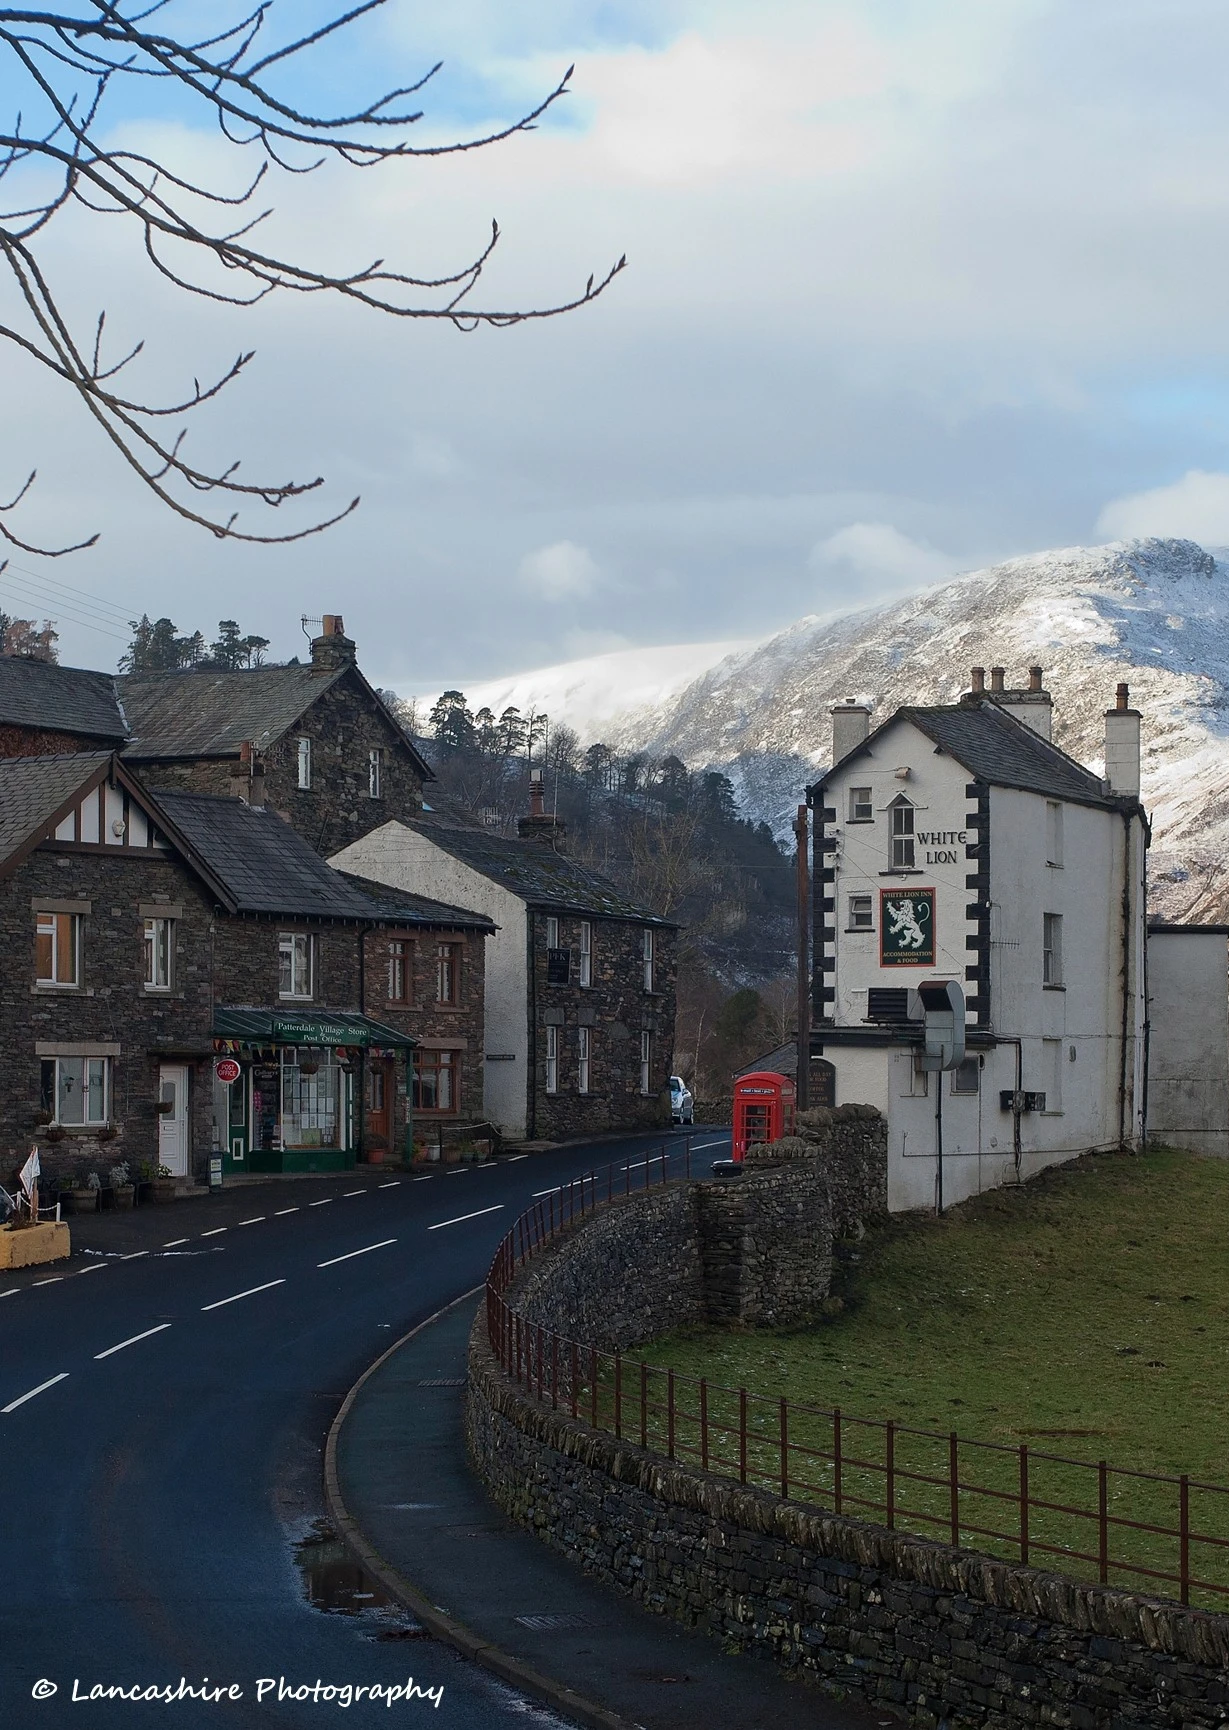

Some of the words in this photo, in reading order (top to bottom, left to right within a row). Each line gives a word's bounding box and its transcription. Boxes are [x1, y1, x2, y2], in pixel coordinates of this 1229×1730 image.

[917, 831, 967, 845] WHITE
[926, 850, 957, 864] LION
[278, 1022, 315, 1032] Patterdale
[319, 1025, 345, 1035] Village
[348, 1027, 367, 1036] Store
[303, 1034, 318, 1042] Post
